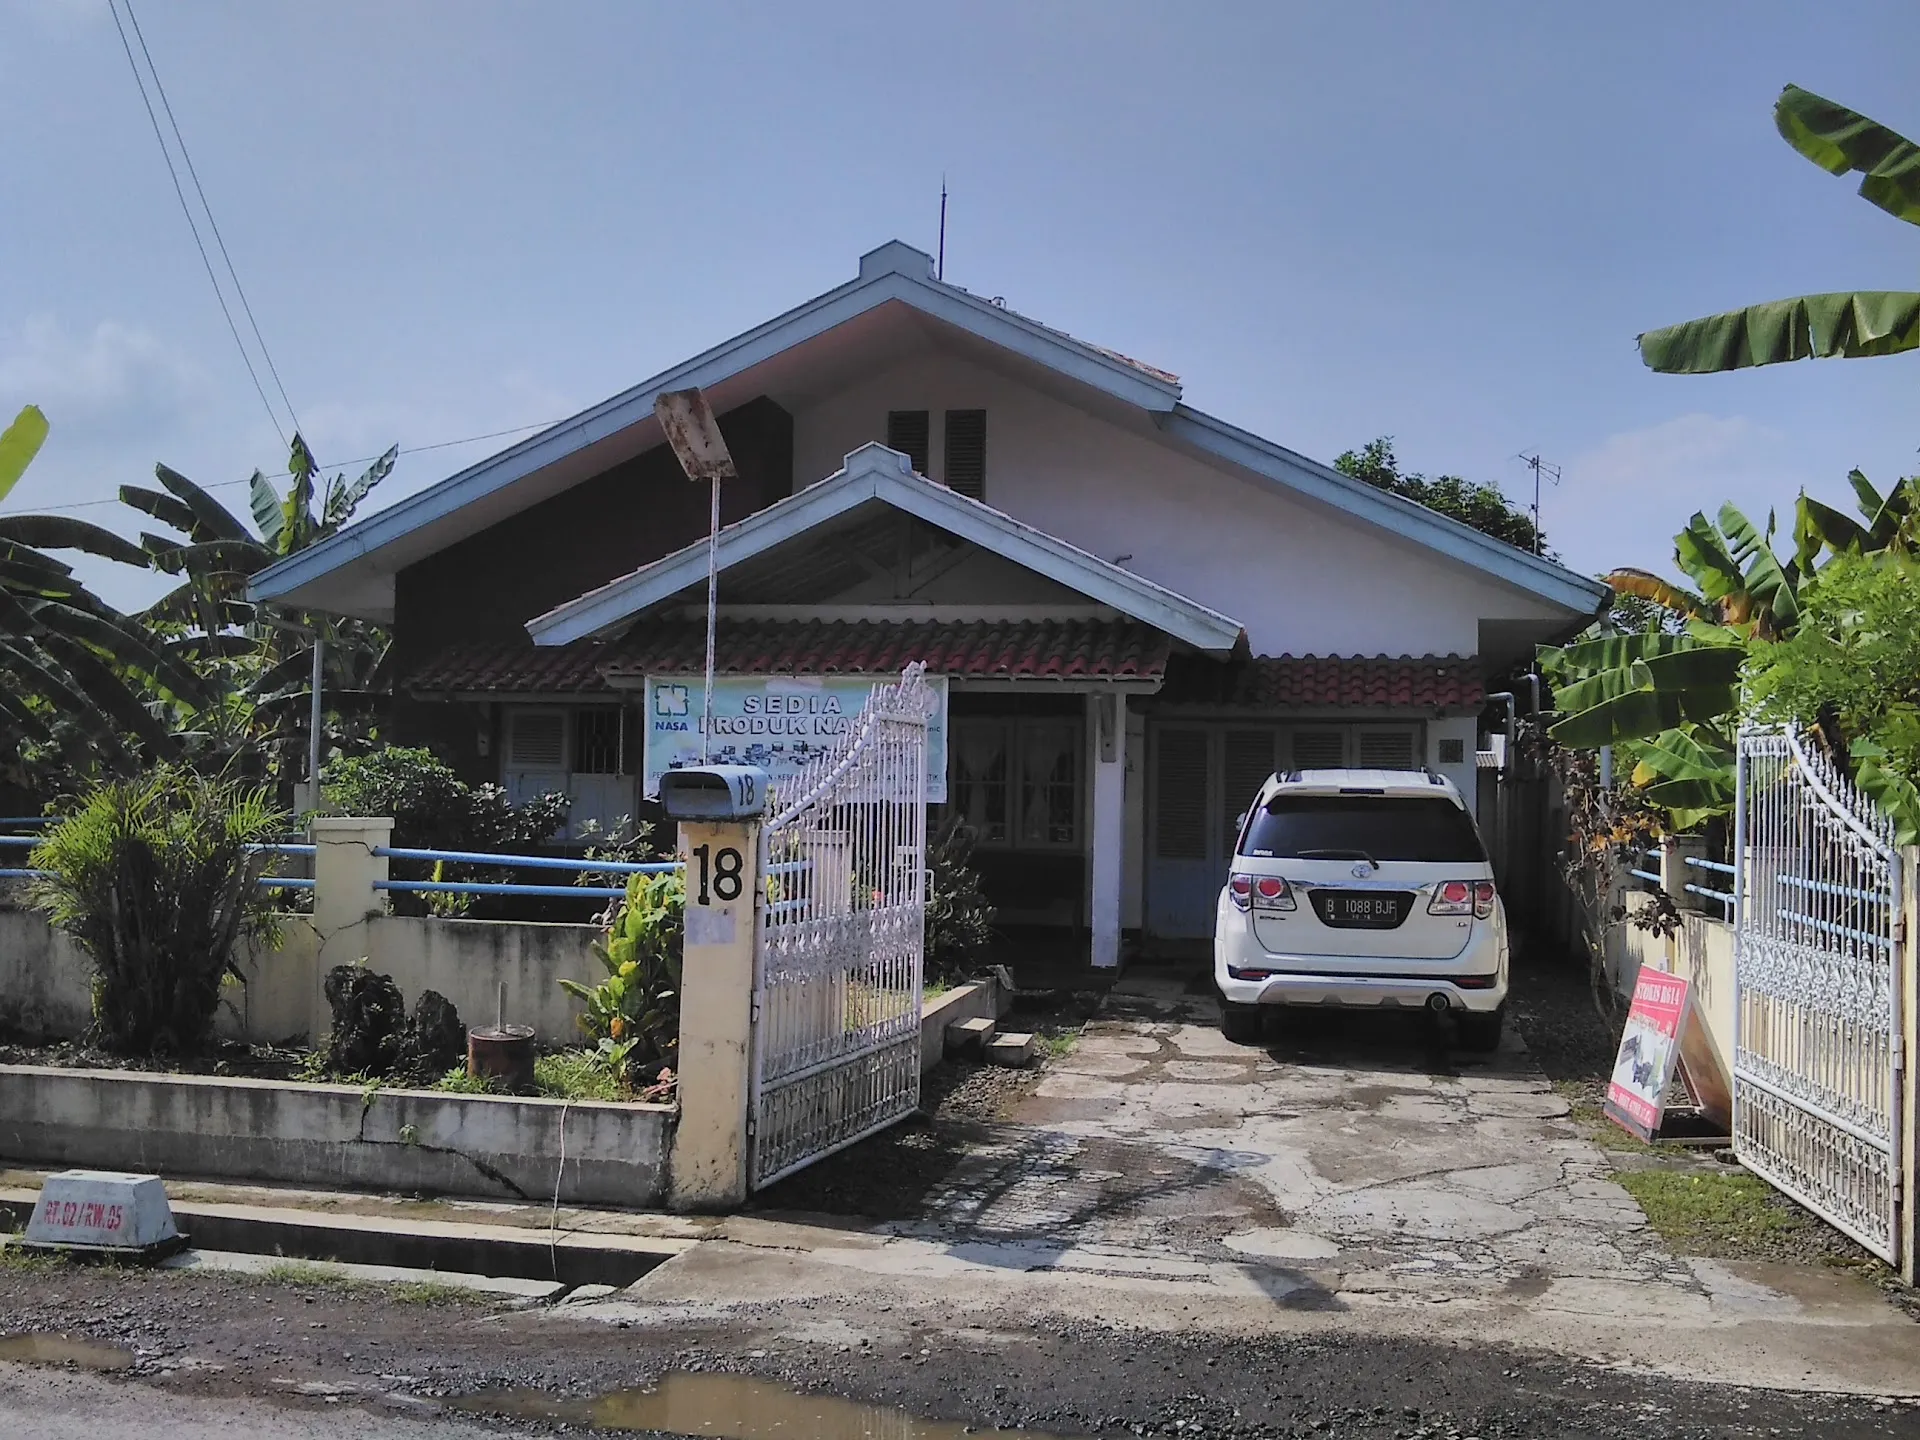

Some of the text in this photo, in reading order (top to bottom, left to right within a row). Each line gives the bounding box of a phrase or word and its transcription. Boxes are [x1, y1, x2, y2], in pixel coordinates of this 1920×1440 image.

[744, 695, 842, 714] SEDIA
[655, 721, 688, 731] NASA
[814, 716, 868, 735] NA
[738, 774, 754, 806] 18
[693, 844, 743, 906] 18
[1327, 899, 1396, 914] B 1088 BJF
